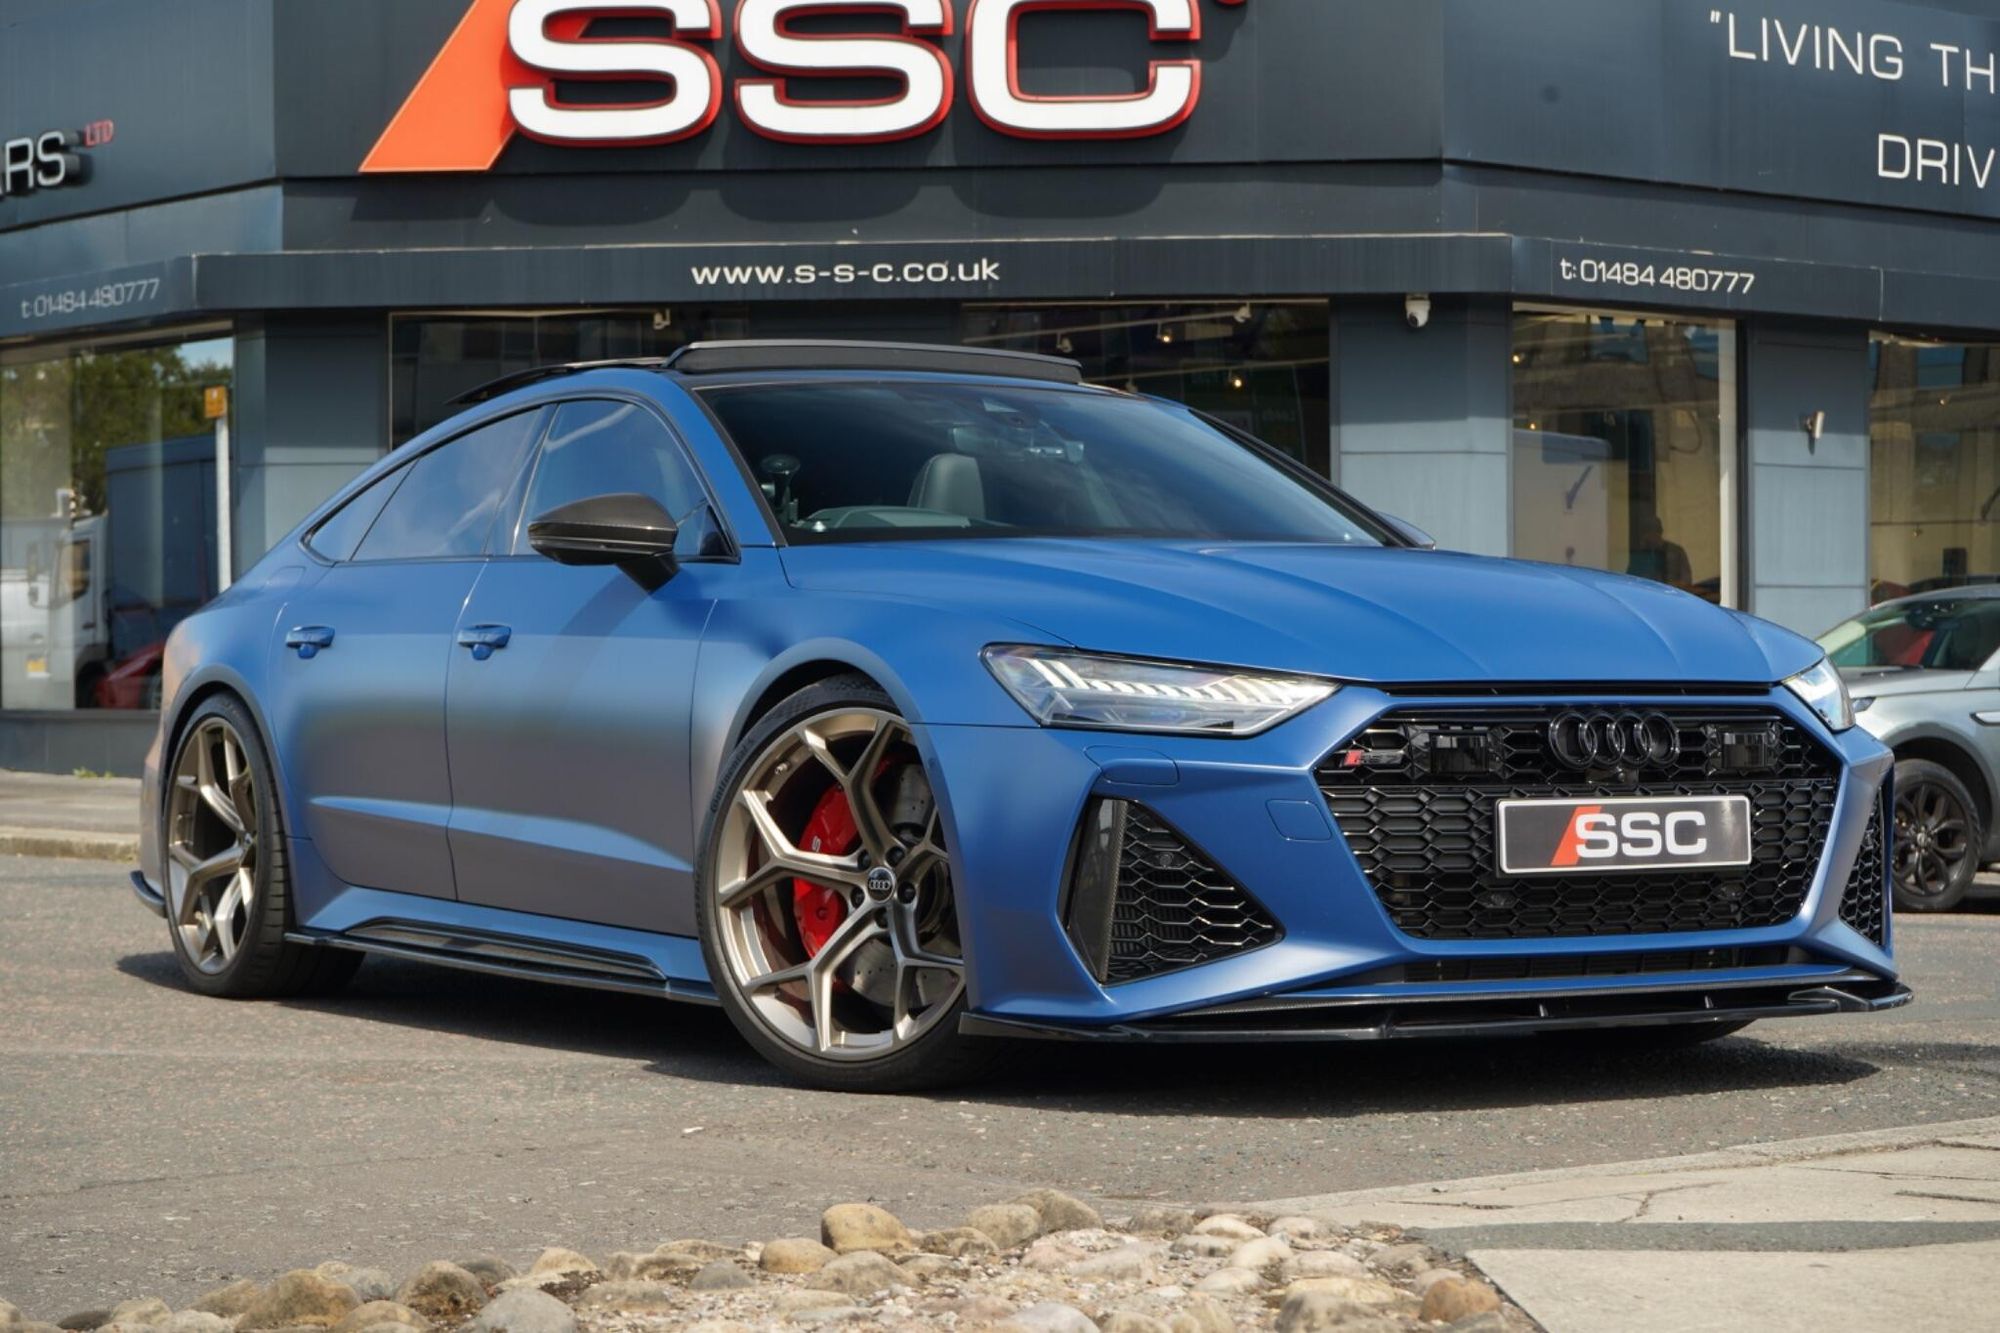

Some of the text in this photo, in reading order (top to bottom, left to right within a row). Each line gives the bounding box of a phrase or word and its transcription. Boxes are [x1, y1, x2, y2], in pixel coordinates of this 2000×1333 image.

[507, 0, 1201, 146] SSC
[0, 118, 114, 196] RS LTD
[1878, 133, 1995, 189] DRIV
[88, 278, 160, 309] 480777
[691, 258, 1000, 285] www.s-s-c.co.uk
[1659, 266, 1755, 294] 480777
[1575, 810, 1707, 858] SSC
